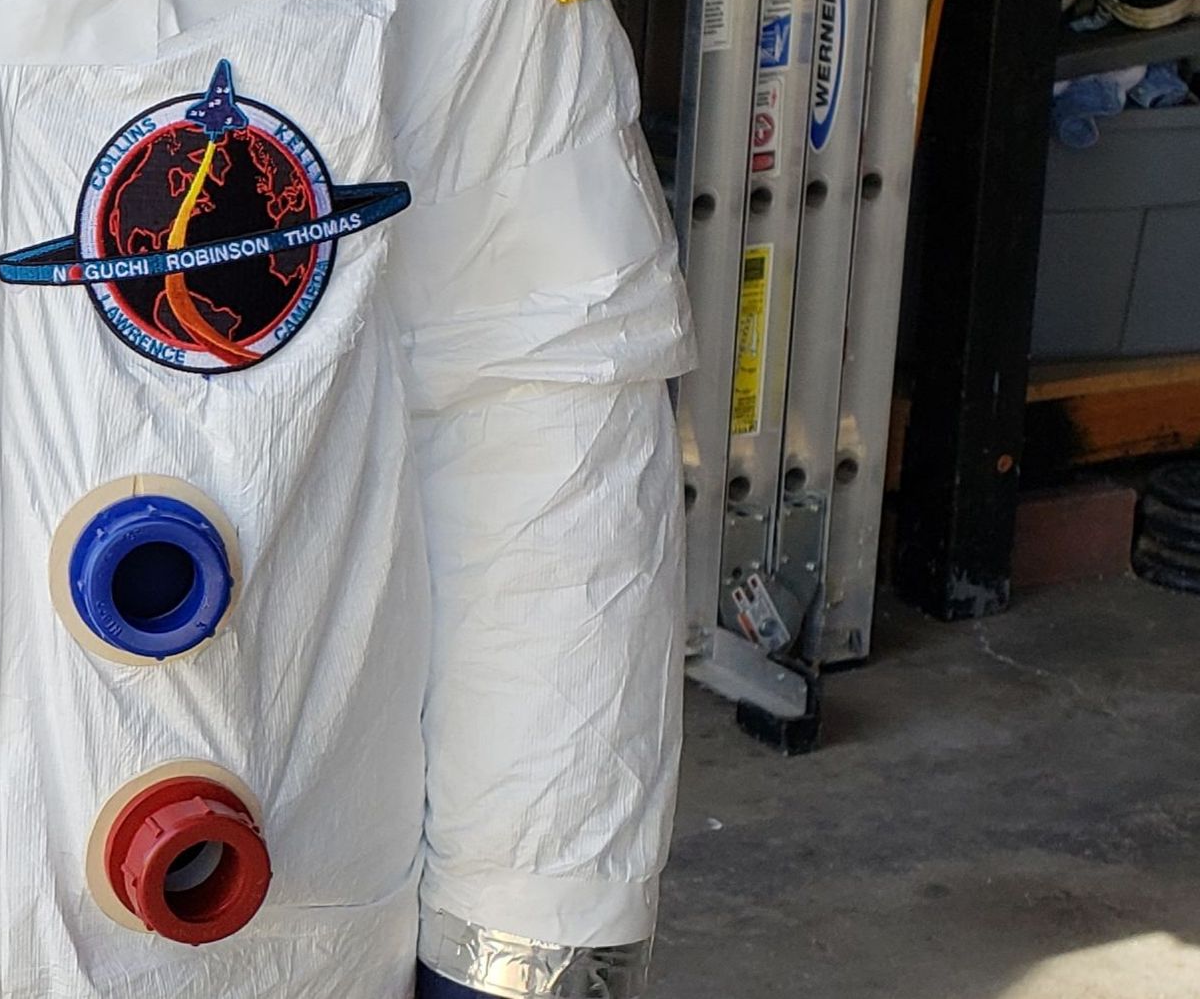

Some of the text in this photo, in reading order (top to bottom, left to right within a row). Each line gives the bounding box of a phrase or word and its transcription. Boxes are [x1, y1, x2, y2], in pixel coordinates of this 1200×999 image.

[91, 117, 157, 191] COLLINS
[274, 122, 327, 184] KELLY
[166, 236, 270, 272] ROBINSON
[283, 212, 362, 247] THOMAS
[100, 293, 186, 364] LAWRENCE
